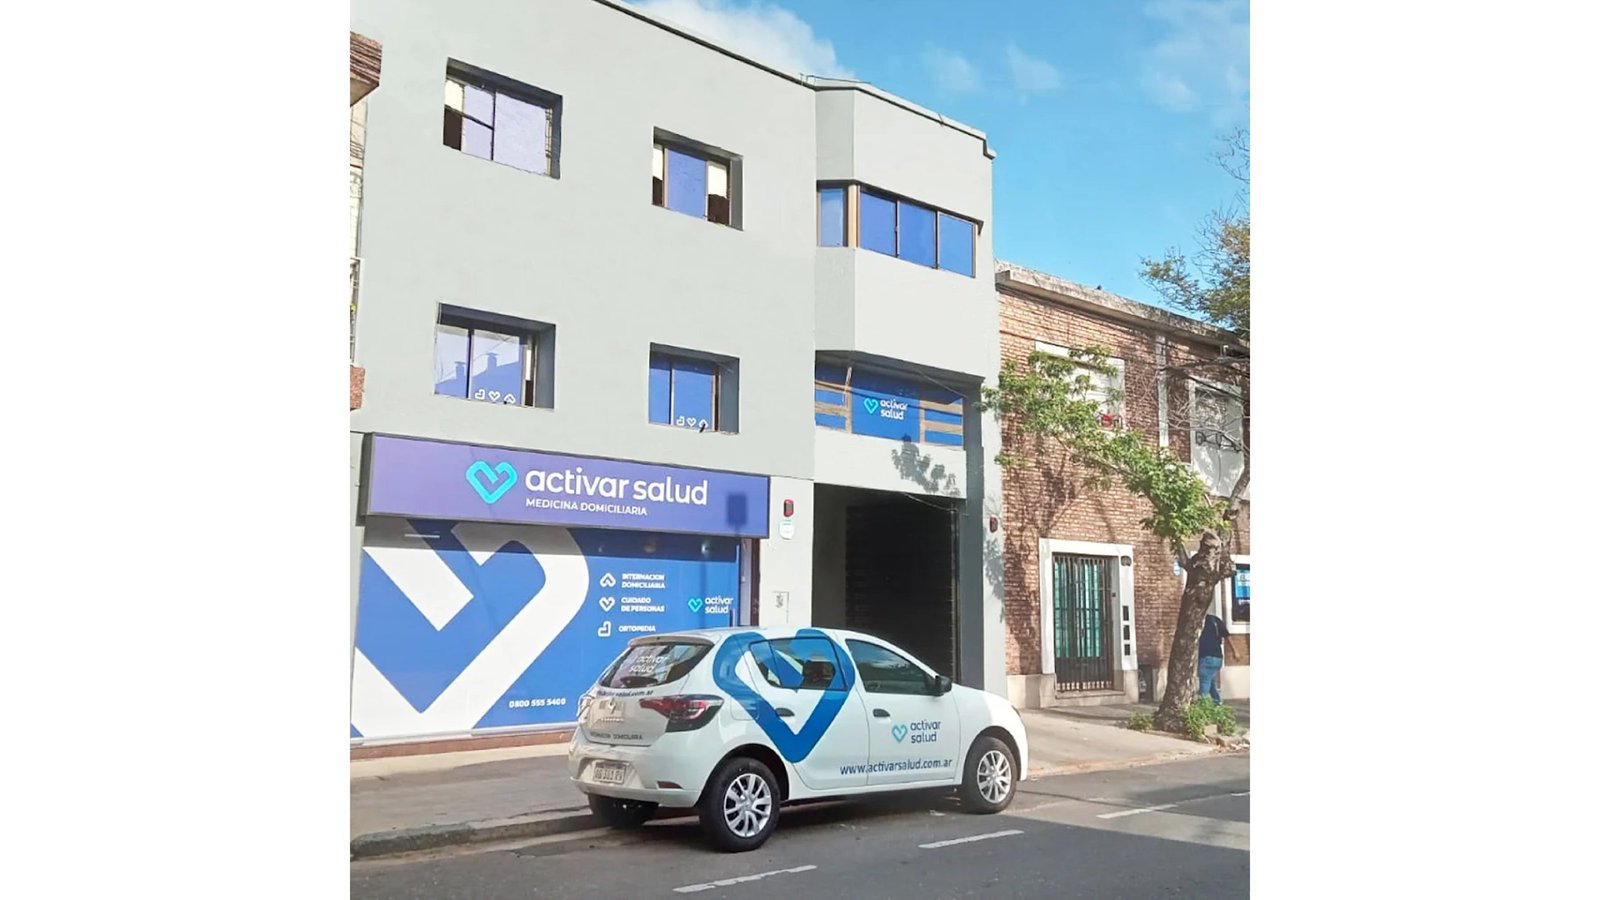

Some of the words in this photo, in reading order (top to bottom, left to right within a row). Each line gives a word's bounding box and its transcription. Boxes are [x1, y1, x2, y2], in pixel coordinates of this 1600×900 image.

[880, 398, 908, 411] activar
[880, 409, 904, 420] salud
[525, 467, 629, 498] activar
[633, 476, 708, 505] salud
[525, 498, 578, 510] MEDICINA
[581, 502, 647, 516] DOMICILIARIA
[704, 595, 734, 605] activar
[704, 604, 729, 614] salud
[508, 700, 530, 708] 0800
[546, 697, 566, 706] 5400
[910, 718, 941, 731] activar
[910, 731, 937, 744] salud
[840, 758, 952, 775] www.activarsalud.com.ar
